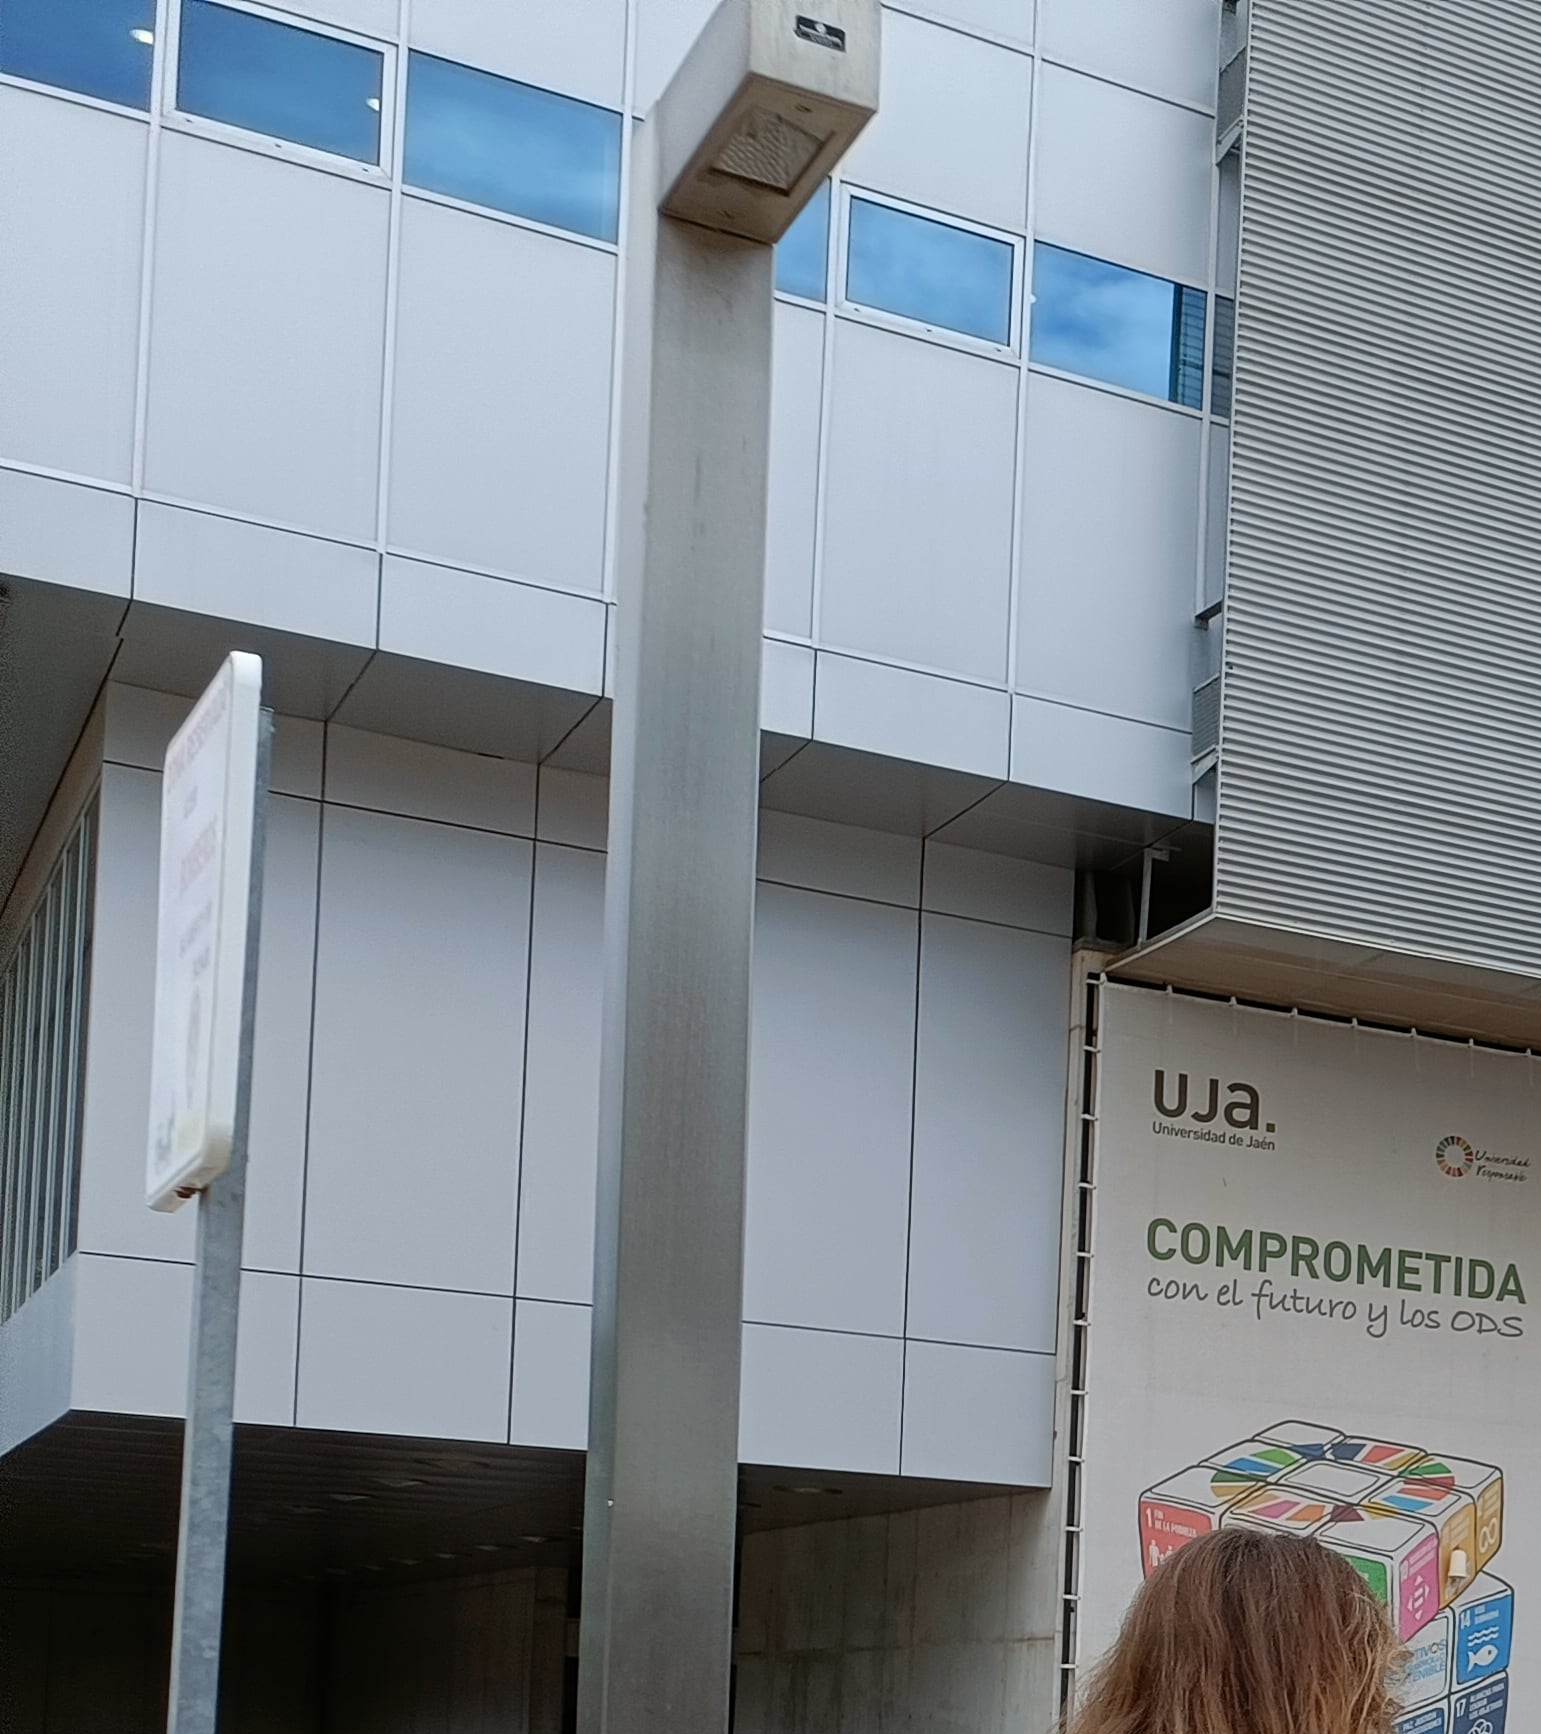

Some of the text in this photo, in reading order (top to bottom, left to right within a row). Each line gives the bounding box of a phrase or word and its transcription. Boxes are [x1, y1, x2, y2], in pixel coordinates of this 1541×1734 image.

[1152, 1120, 1276, 1151] Universidad de Jaén
[1147, 1217, 1527, 1305] COMPROMETIDA
[1147, 1277, 1523, 1338] con el futuro y los ODS
[1460, 1609, 1471, 1630] 14
[1456, 1697, 1467, 1718] 17
